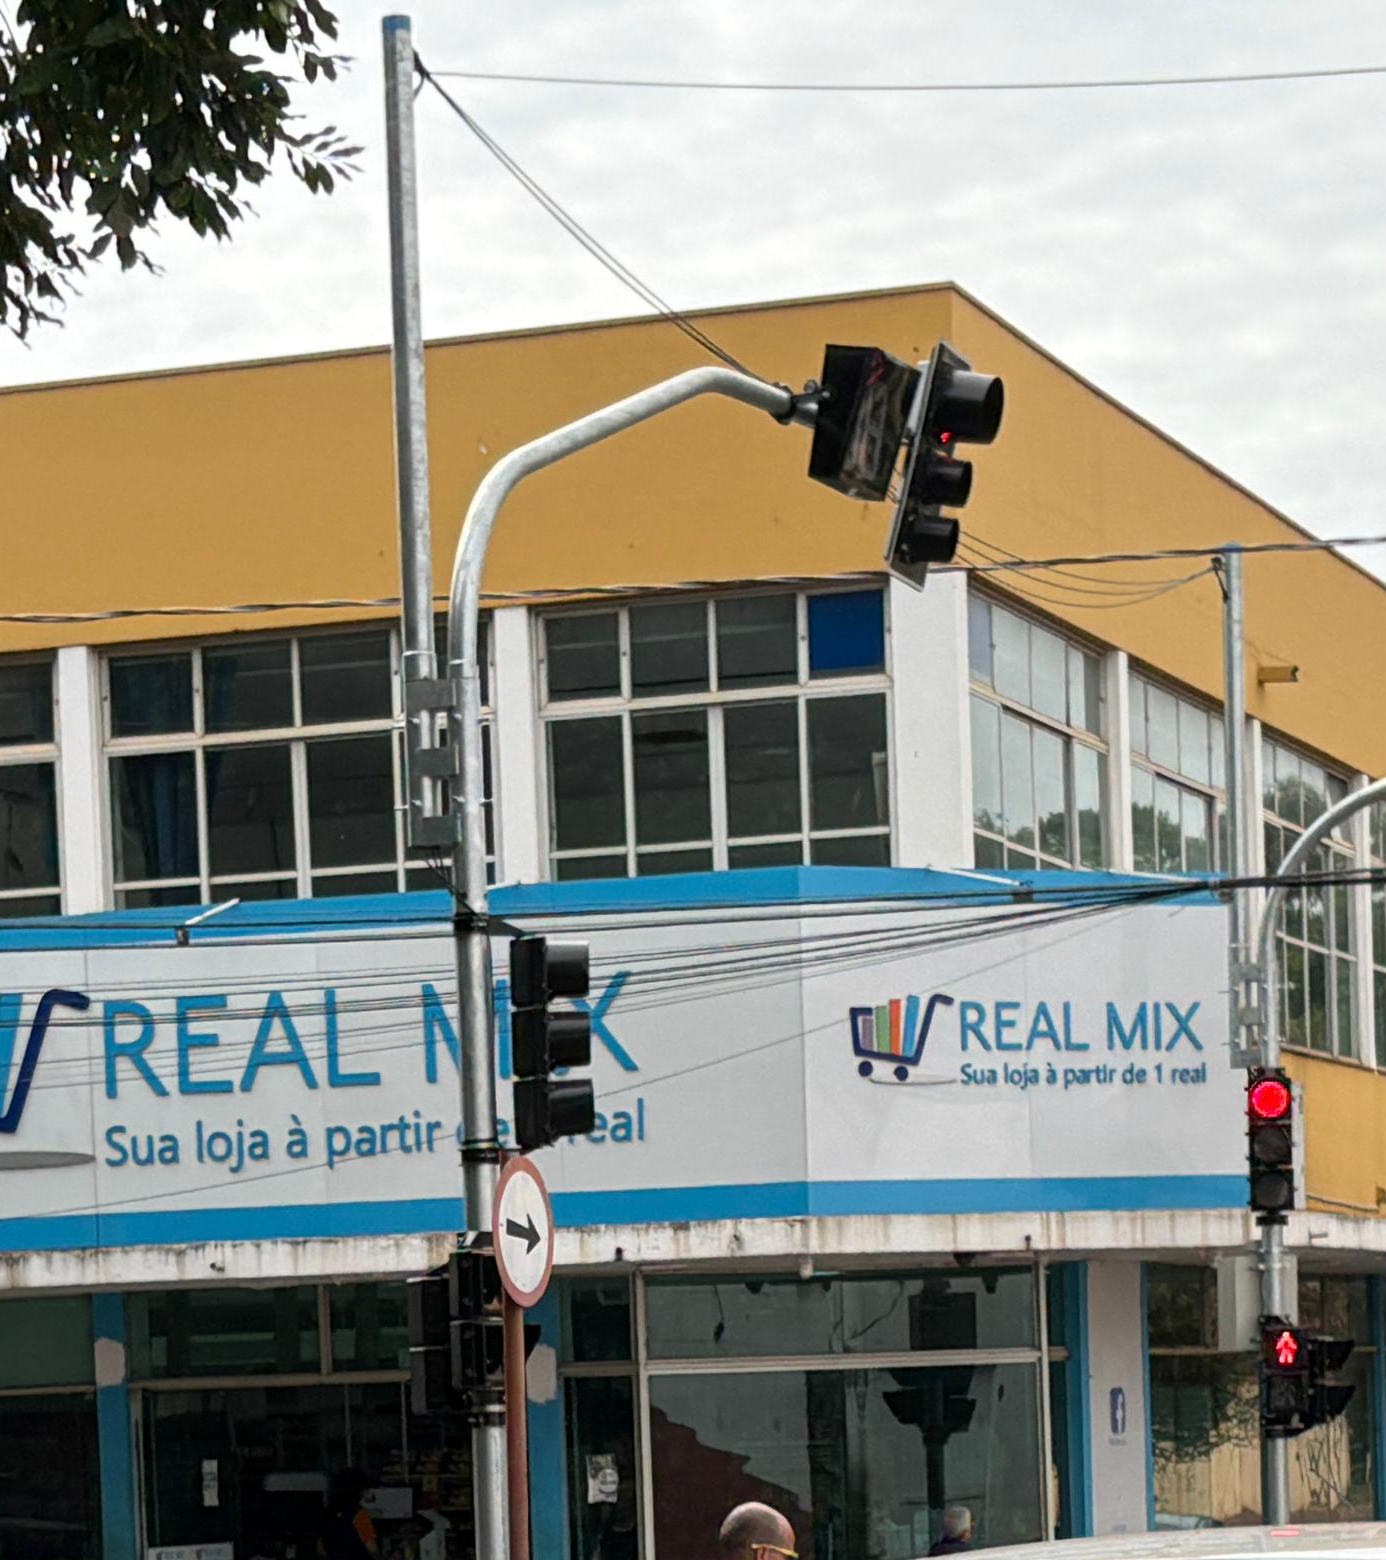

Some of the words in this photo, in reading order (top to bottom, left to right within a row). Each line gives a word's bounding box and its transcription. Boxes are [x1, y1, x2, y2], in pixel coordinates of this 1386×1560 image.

[102, 987, 381, 1099] REAL
[421, 971, 639, 1084] MX
[959, 1000, 1090, 1052] REAL
[1106, 1001, 1204, 1052] MIX
[959, 1063, 998, 1085] Sua
[1003, 1062, 1040, 1090] loja
[1045, 1062, 1058, 1085] à
[1063, 1062, 1116, 1090] partir
[1122, 1062, 1148, 1084] de
[1154, 1063, 1163, 1084] 1
[1171, 1062, 1207, 1084] real
[105, 1124, 180, 1167] Sua
[196, 1119, 269, 1174] loja
[285, 1114, 308, 1159] à
[326, 1110, 442, 1169] partir
[568, 1098, 645, 1145] eal
